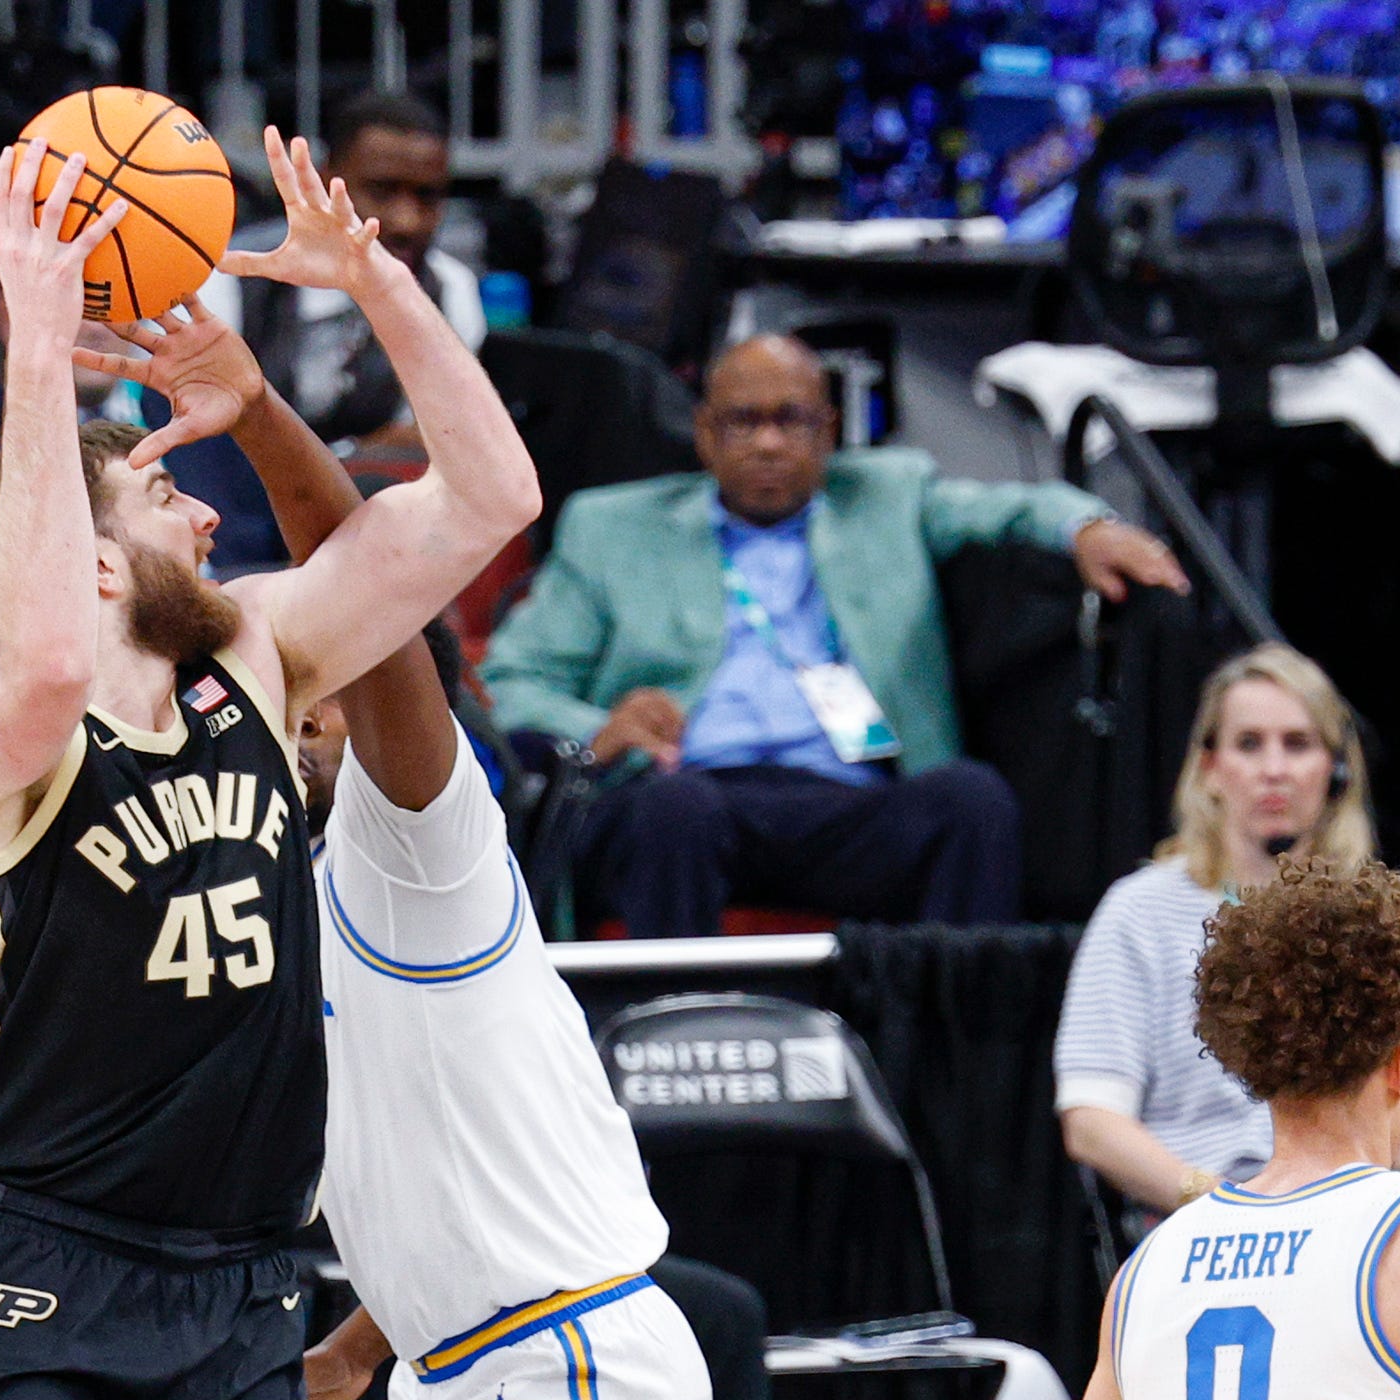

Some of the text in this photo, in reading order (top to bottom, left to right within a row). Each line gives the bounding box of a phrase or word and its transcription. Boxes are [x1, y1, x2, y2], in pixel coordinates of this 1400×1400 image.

[74, 771, 289, 896] PURDUE
[146, 876, 275, 998] 45
[613, 1038, 778, 1071] UNITED
[622, 1072, 782, 1105] CENTER
[1181, 1229, 1313, 1283] PERRY
